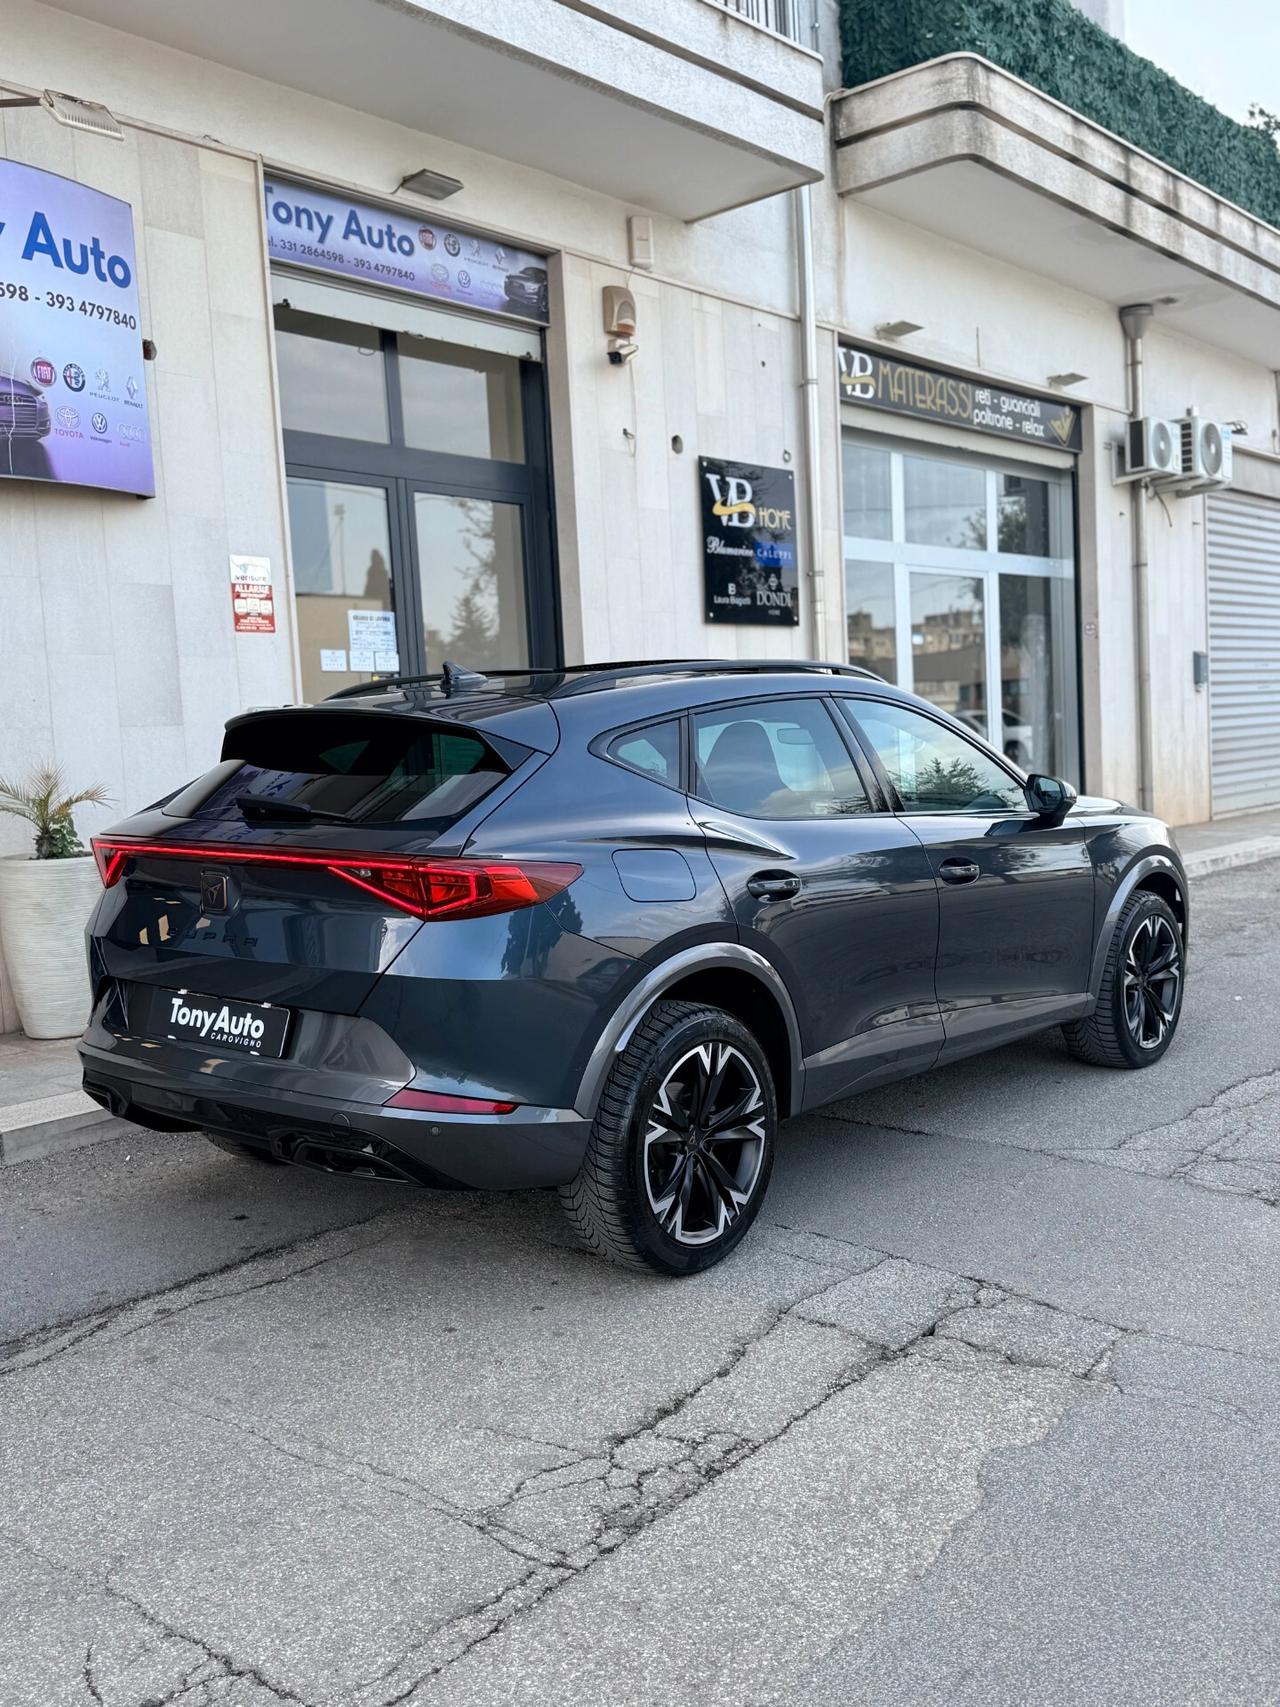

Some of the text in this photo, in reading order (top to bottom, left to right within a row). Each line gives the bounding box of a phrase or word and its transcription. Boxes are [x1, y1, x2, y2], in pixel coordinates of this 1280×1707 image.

[21, 210, 132, 289] Auto
[342, 208, 415, 257] Auto
[280, 239, 298, 252] 331
[301, 244, 344, 264] 2864598
[353, 257, 372, 270] 393
[373, 261, 415, 281] 4797840
[46, 291, 75, 312] 393
[79, 300, 137, 330] 4797840
[877, 361, 972, 420] MATERASSI
[54, 428, 85, 440] TOYOTA
[1022, 417, 1045, 437] relax
[758, 507, 792, 530] HOME
[210, 1032, 262, 1048] CAROVIGNO
